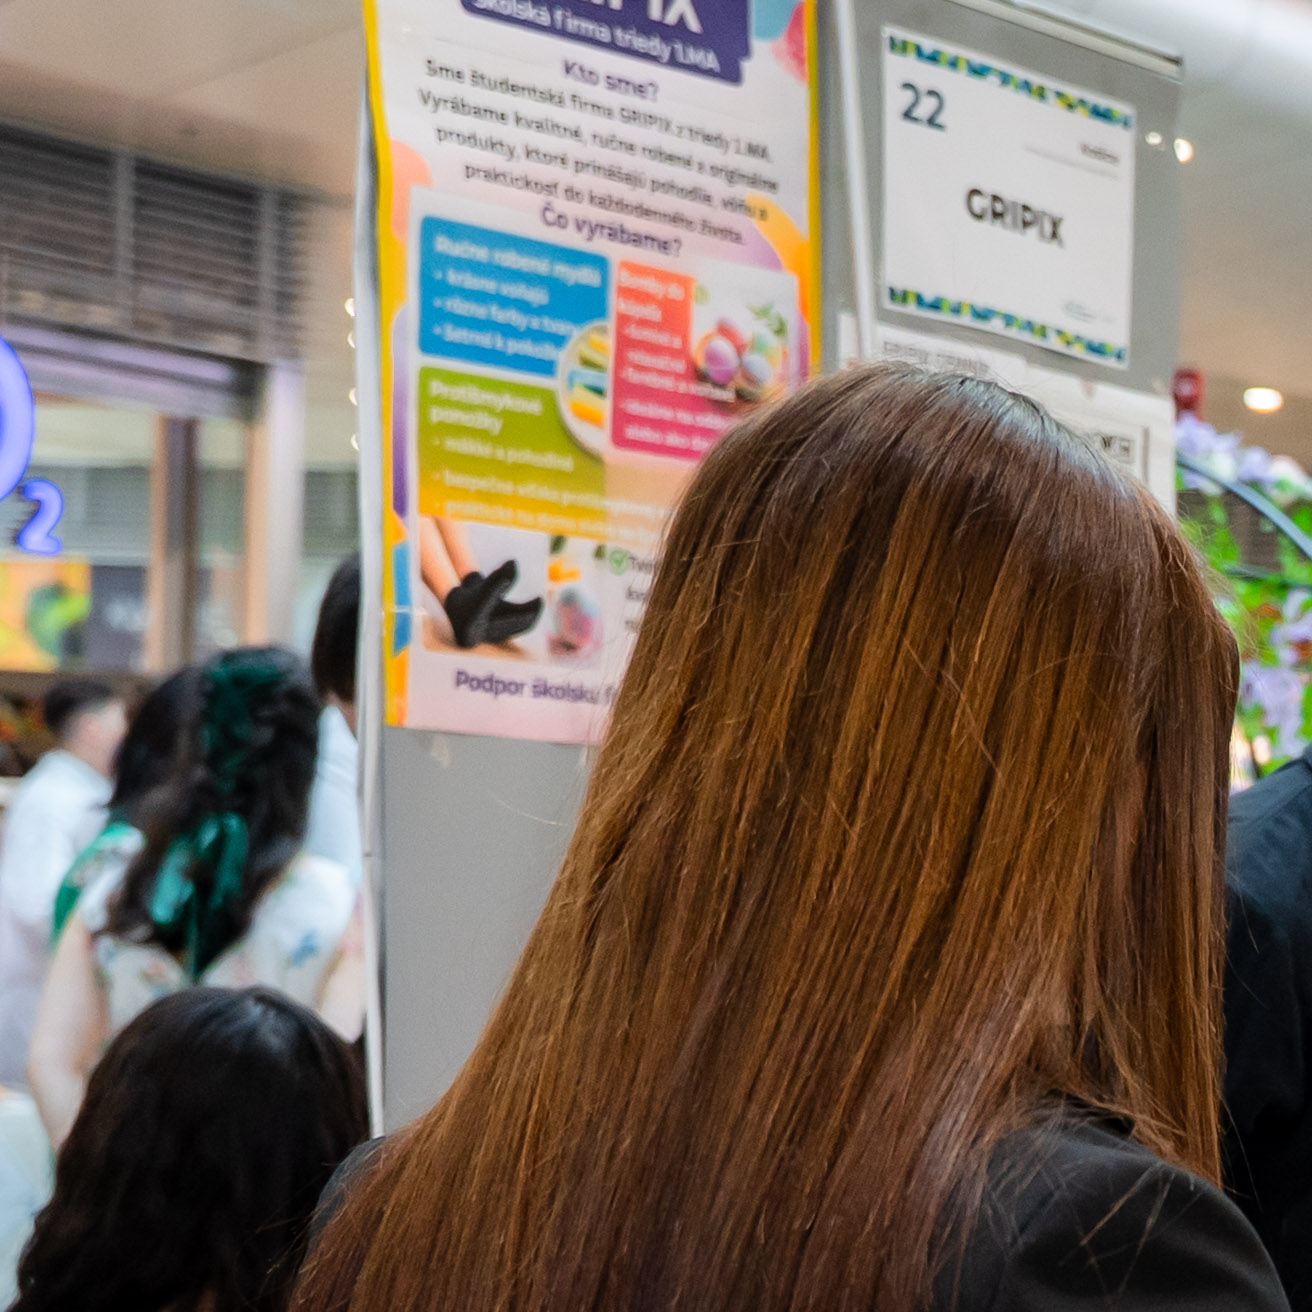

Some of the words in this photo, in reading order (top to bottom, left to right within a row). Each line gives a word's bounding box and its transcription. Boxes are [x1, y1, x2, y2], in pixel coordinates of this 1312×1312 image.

[553, 7, 612, 43] firma
[613, 26, 672, 63] triedy
[426, 59, 465, 84] Sme
[570, 92, 615, 119] firma
[562, 59, 600, 86] Kto
[604, 74, 659, 103] sme?
[417, 87, 509, 126] Vyrábame
[900, 82, 947, 132] 22
[435, 127, 521, 163] produkty,
[541, 201, 569, 230] Čo
[574, 217, 683, 259] vyrábame?
[966, 188, 1065, 248] GRIPIX
[455, 668, 527, 700] Podpor
